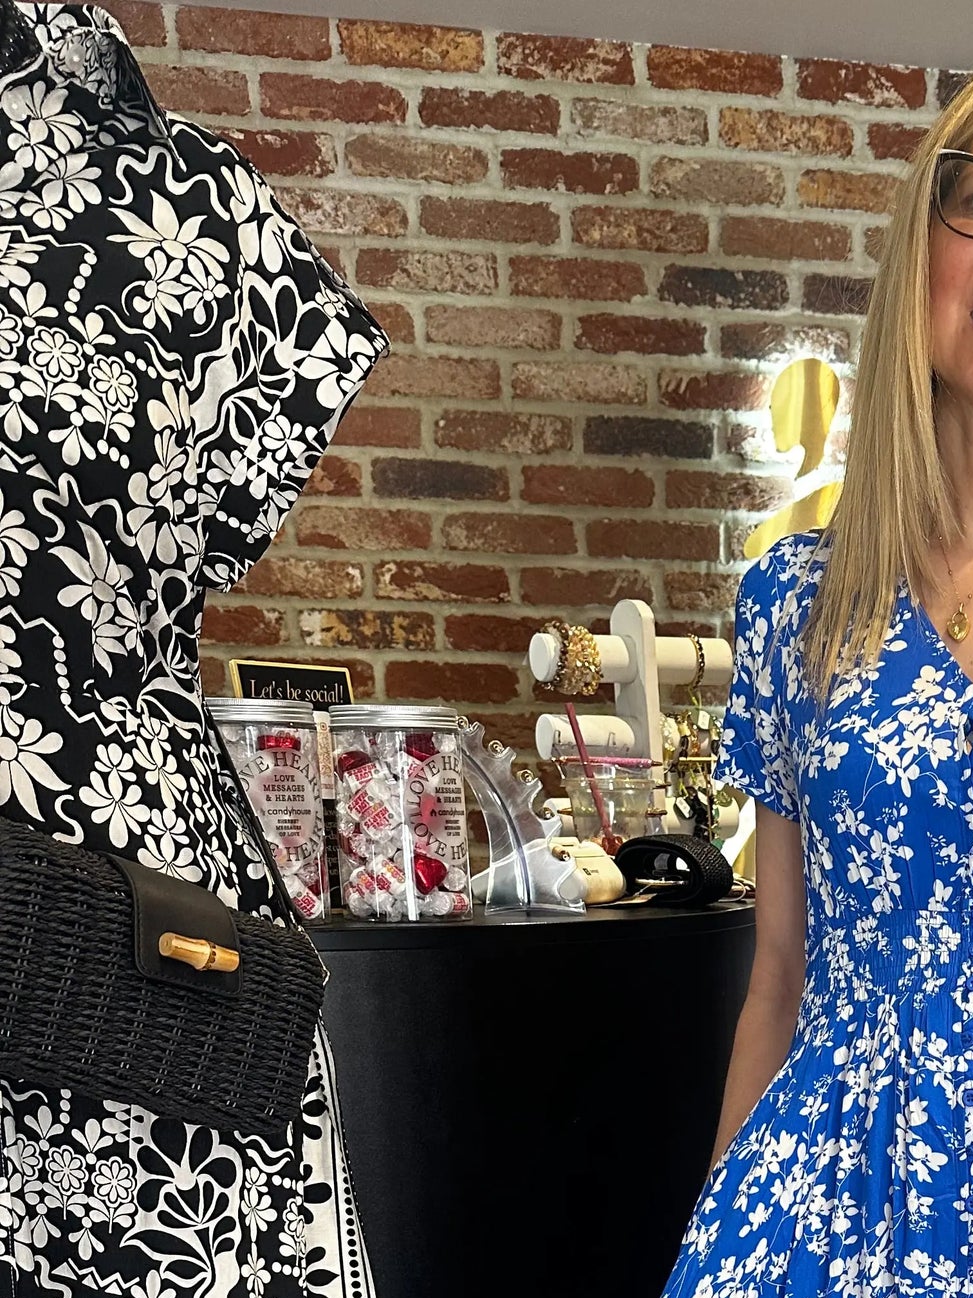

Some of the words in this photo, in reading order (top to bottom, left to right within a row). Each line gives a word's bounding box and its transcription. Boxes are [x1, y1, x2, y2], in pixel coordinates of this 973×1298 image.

[250, 679, 283, 699] Let's
[286, 679, 302, 700] be
[304, 682, 344, 703] social!
[274, 774, 296, 782] LOVE
[263, 784, 305, 792] MESSAGES
[275, 794, 305, 802] HEARTS
[267, 806, 312, 817] candyhouse
